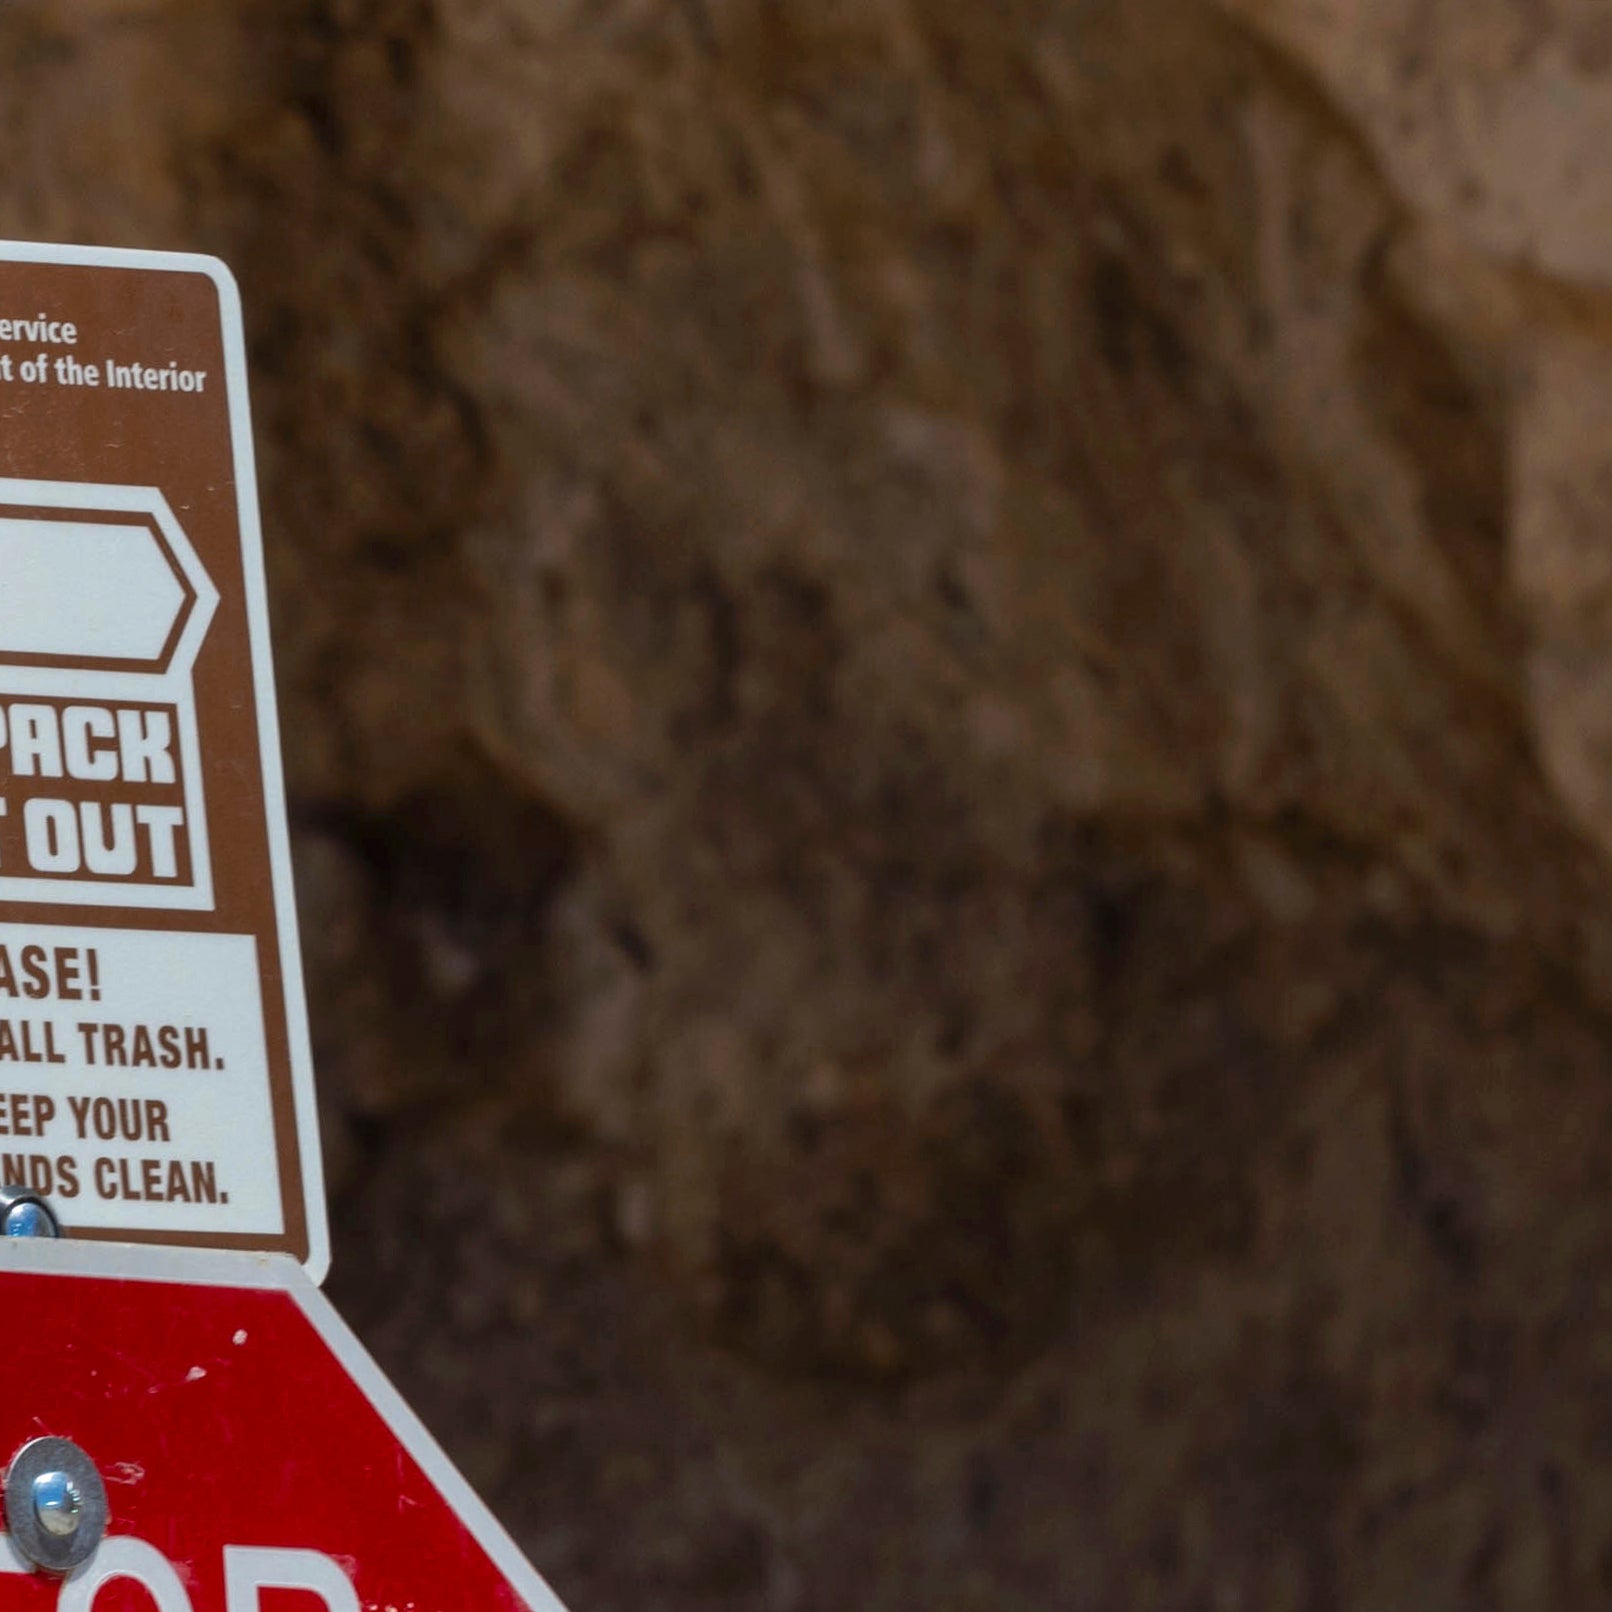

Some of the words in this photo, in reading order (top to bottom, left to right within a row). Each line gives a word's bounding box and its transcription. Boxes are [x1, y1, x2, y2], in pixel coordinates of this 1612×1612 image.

[19, 359, 51, 382] of
[54, 361, 100, 387] the
[107, 360, 206, 393] Interior
[23, 798, 184, 878] OUT
[78, 1023, 225, 1071] TRASH.
[68, 1096, 171, 1143] YOUR
[94, 1156, 229, 1205] CLEAN.
